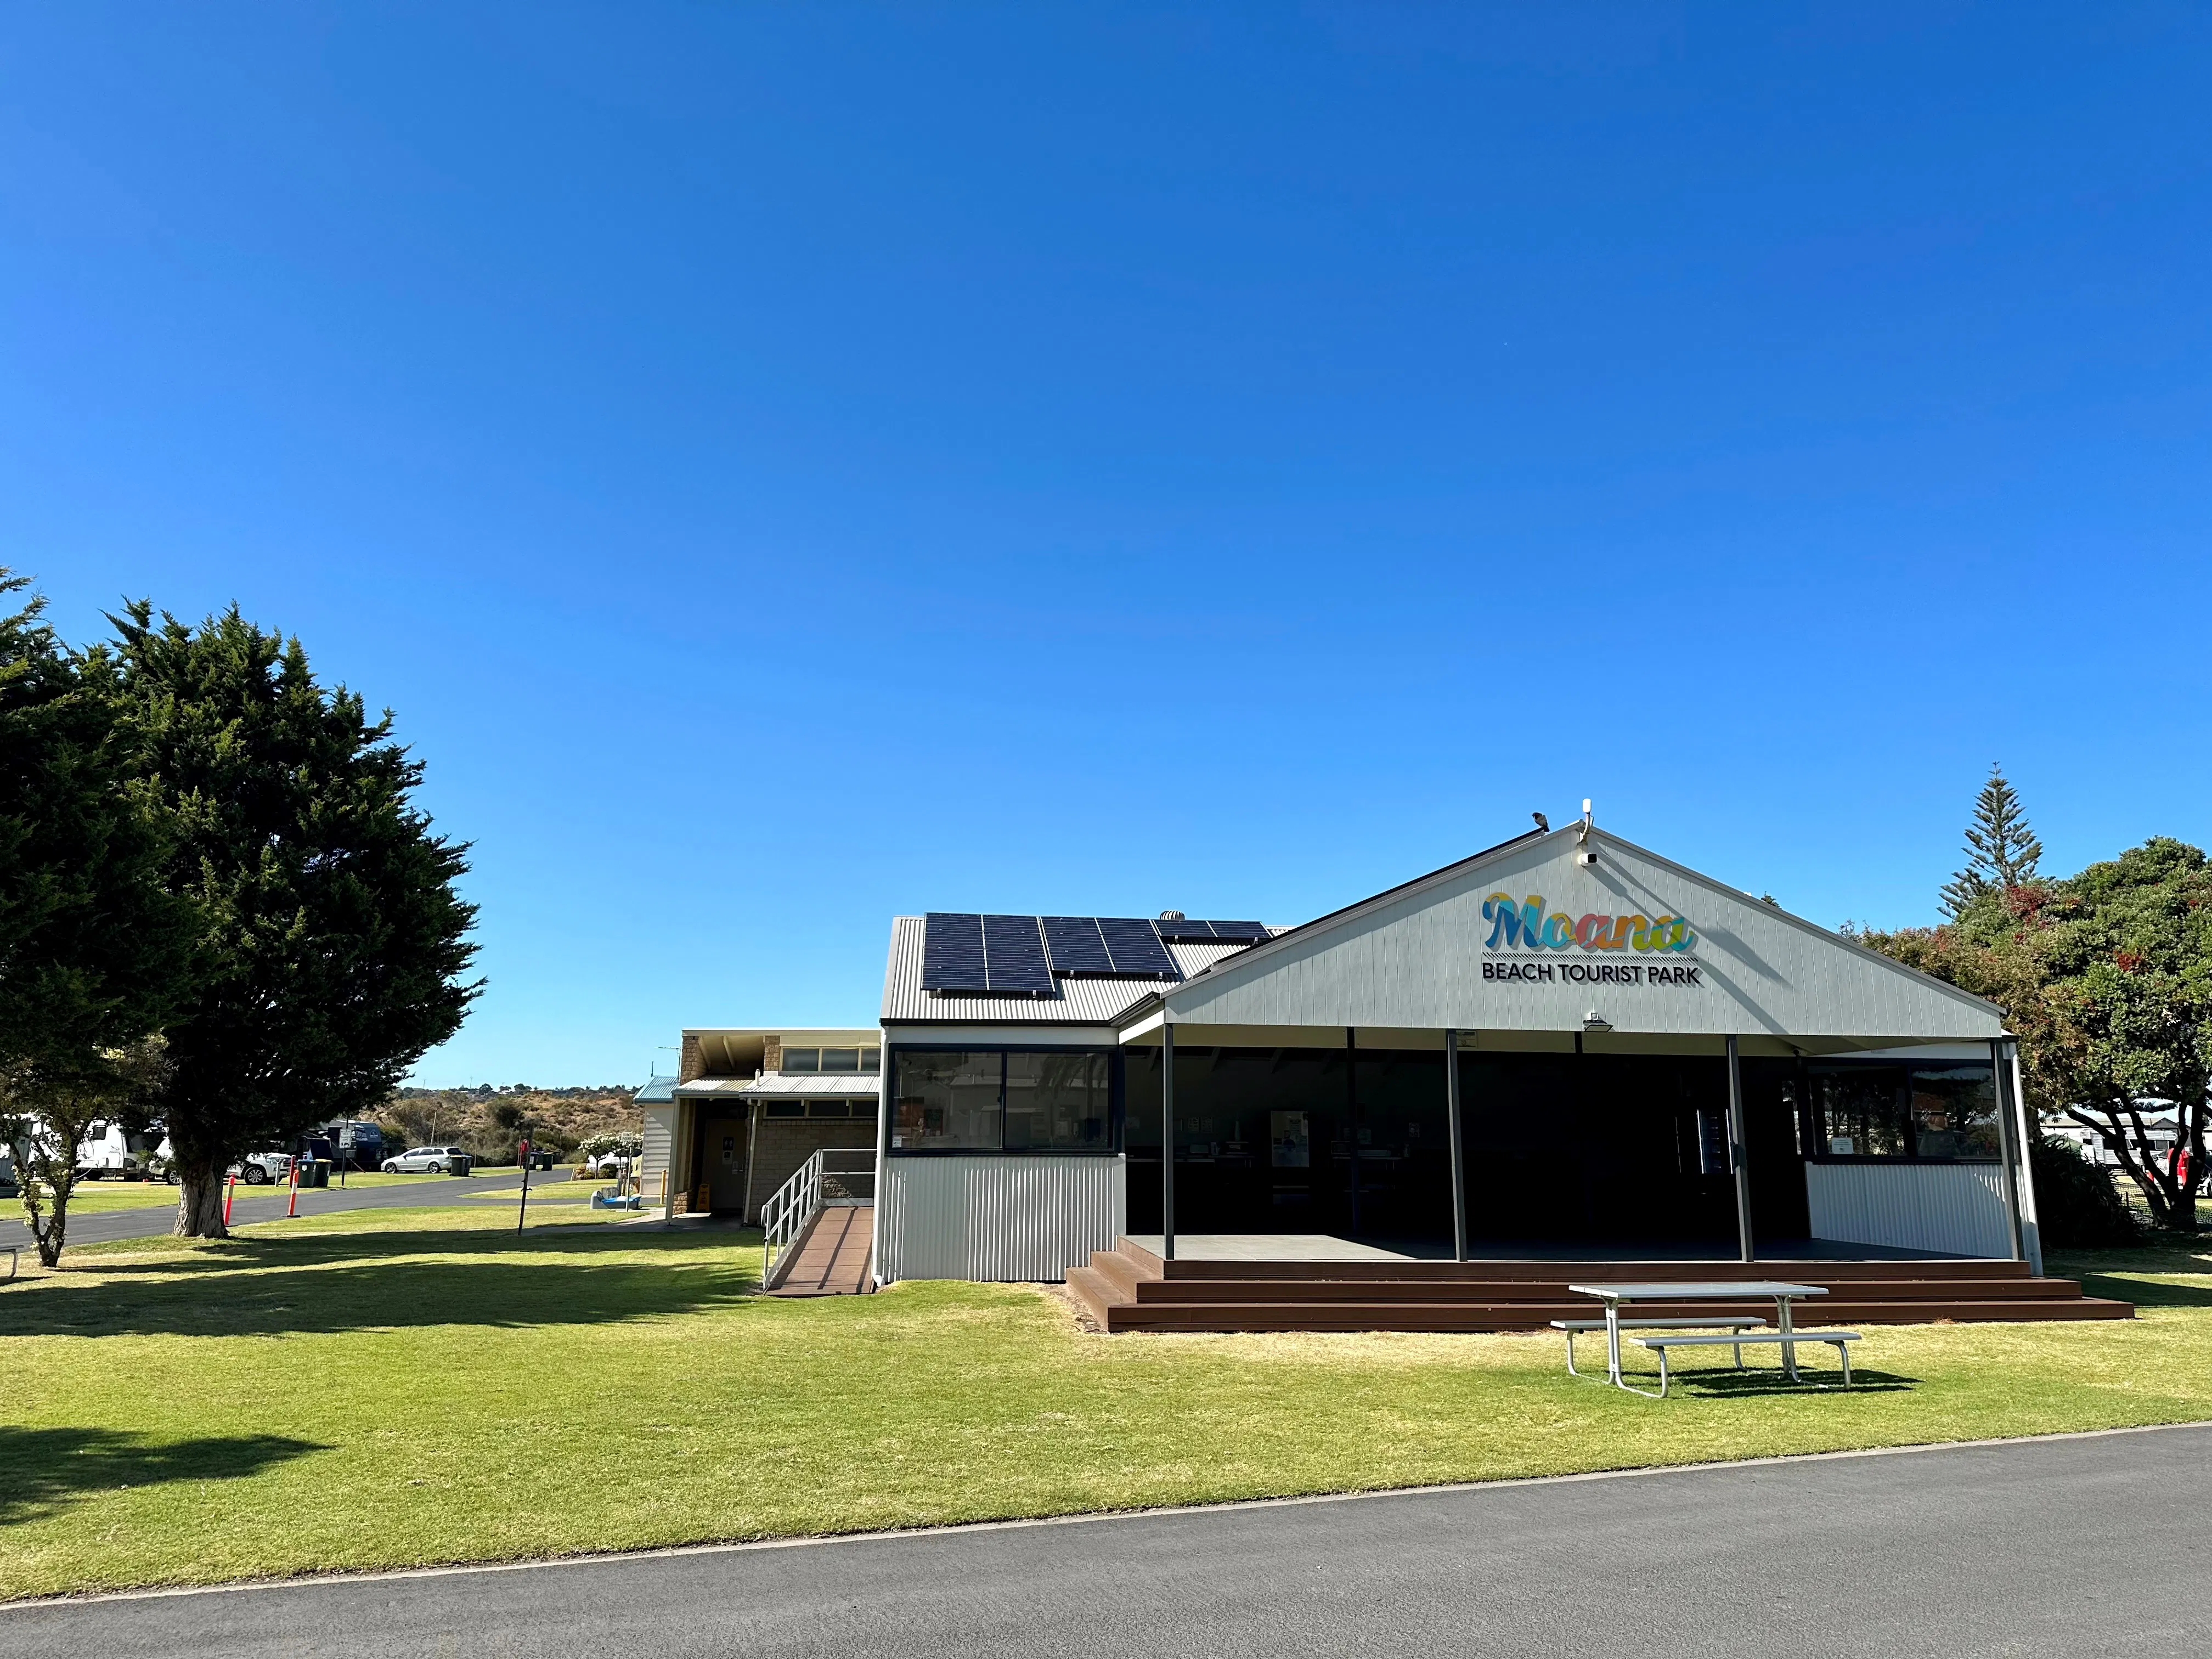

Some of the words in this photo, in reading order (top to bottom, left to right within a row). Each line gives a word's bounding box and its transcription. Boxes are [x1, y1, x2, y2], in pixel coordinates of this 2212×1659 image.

[1482, 892, 1694, 951] Moana
[1482, 962, 1552, 980] BEACH
[1558, 964, 1641, 983] TOURIST
[1648, 967, 1701, 984] PARK
